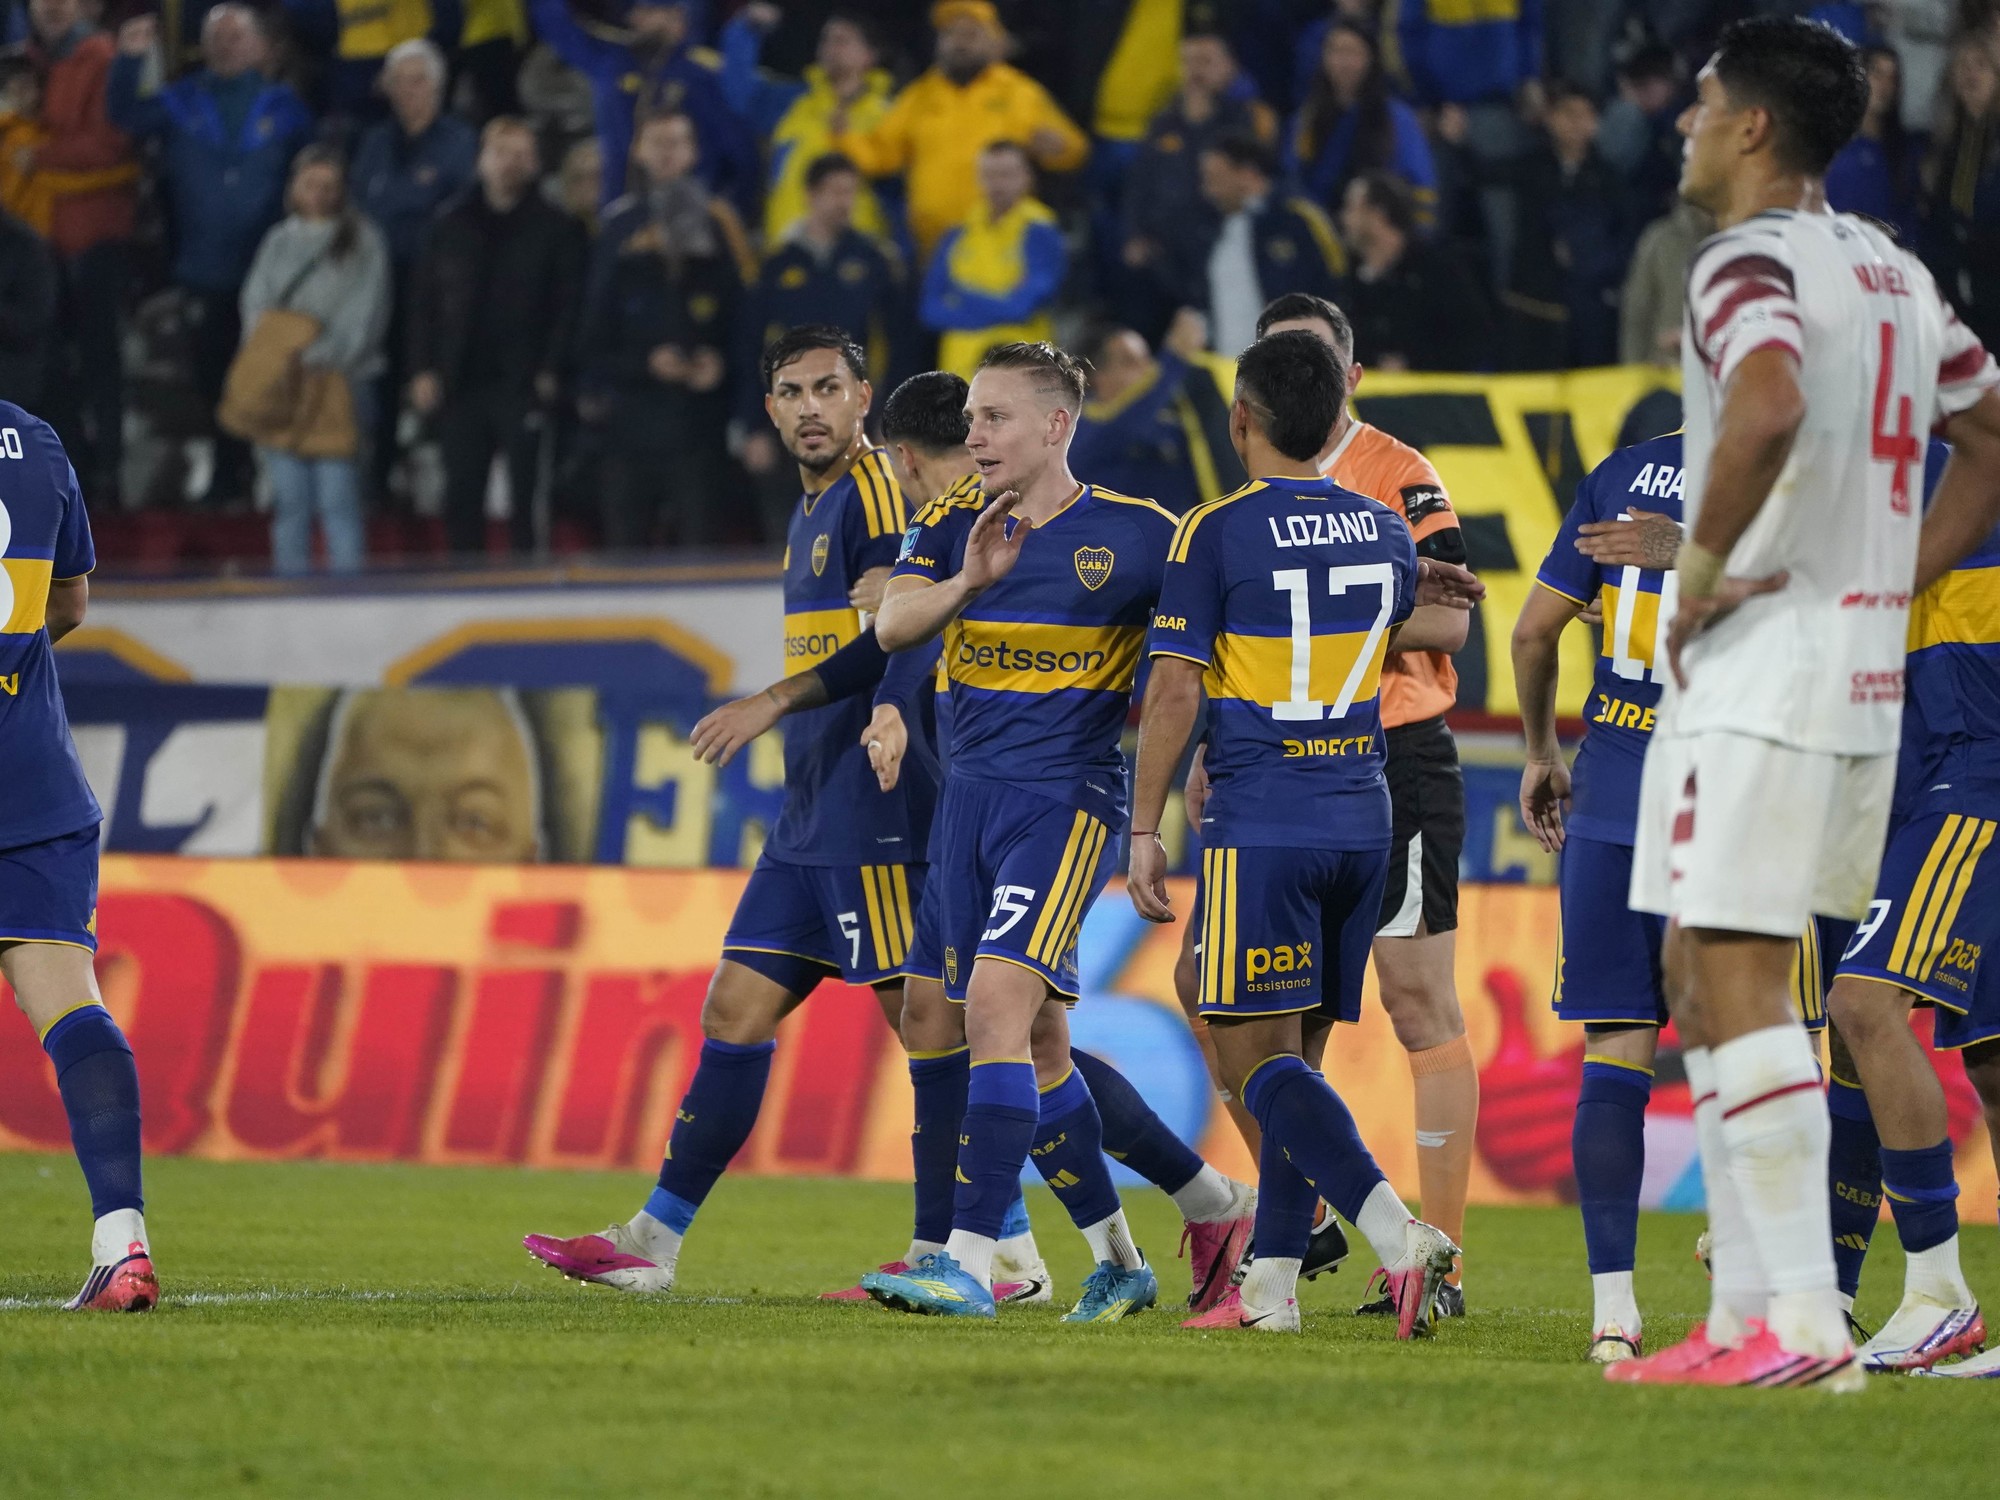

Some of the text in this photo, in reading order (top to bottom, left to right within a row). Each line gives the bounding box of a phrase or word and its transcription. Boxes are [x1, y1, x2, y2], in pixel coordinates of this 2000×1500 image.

[1872, 322, 1921, 516] 4
[1629, 463, 1685, 500] ARA
[1268, 510, 1379, 548] LOZANO
[1079, 560, 1109, 571] CABJ
[784, 631, 839, 657] tsson
[959, 640, 1105, 673] betsson
[1272, 562, 1395, 721] 17
[1593, 693, 1656, 732] DIRE
[1282, 735, 1374, 758] DIRECT
[837, 911, 860, 969] 5
[1840, 899, 1892, 962] 9
[1247, 942, 1313, 981] pax
[1939, 936, 1982, 974] pax
[1247, 977, 1311, 992] assistance
[1030, 1132, 1066, 1156] ABJ
[1836, 1181, 1882, 1208] CABJ
